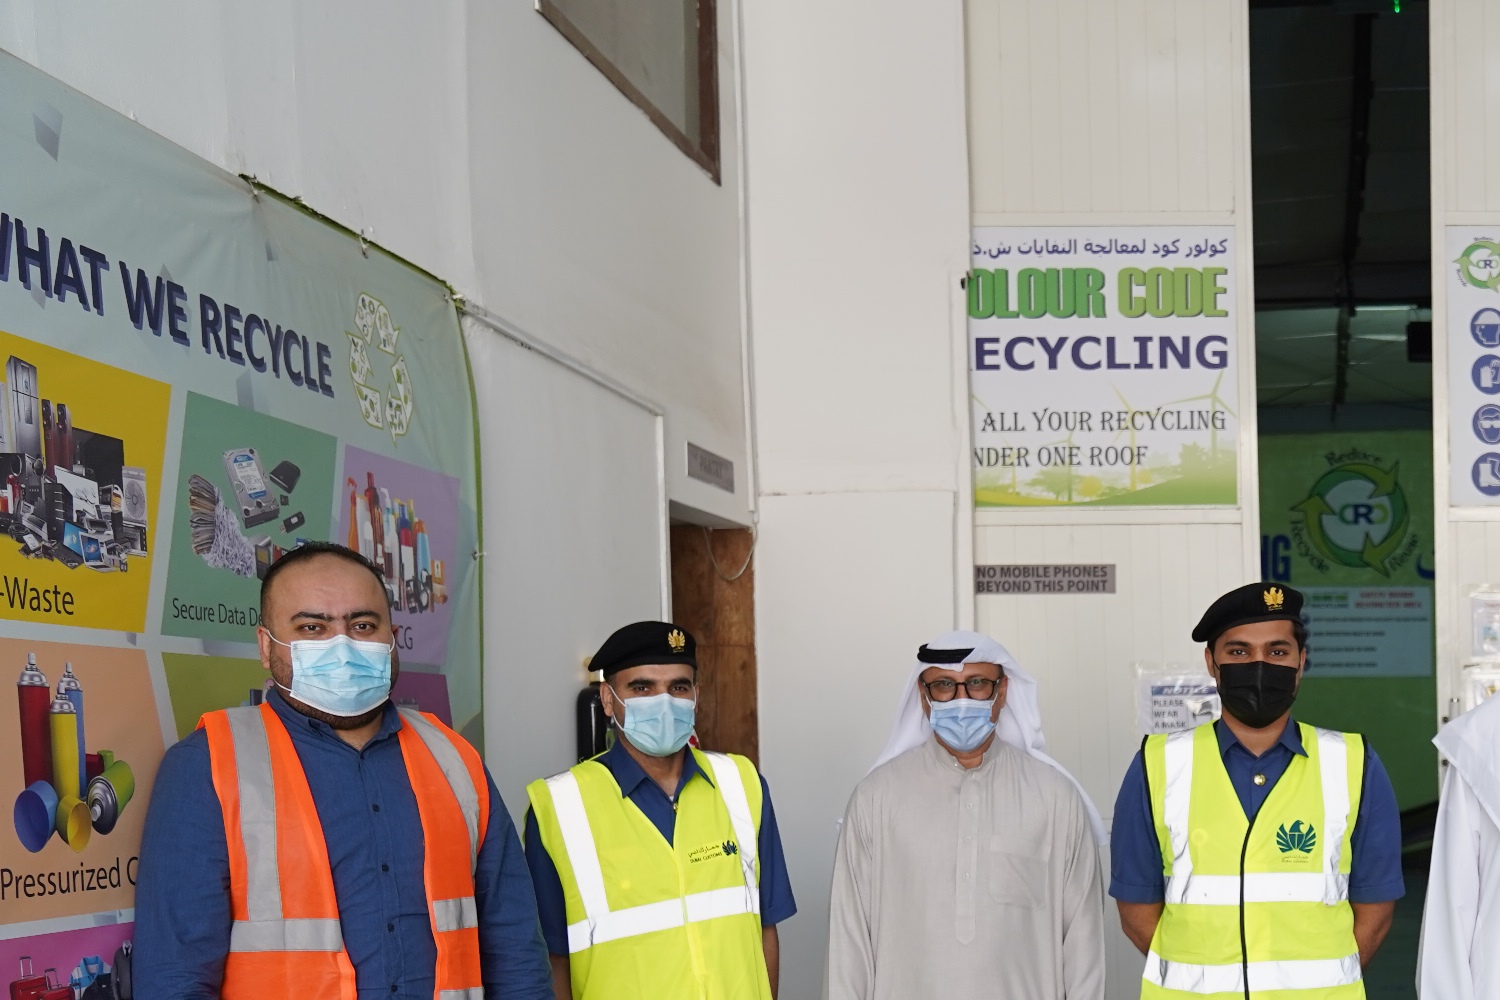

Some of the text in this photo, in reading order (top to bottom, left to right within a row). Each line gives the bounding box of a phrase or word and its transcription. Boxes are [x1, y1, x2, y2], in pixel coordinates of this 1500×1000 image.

[1017, 239, 1078, 258] النفايات
[1084, 238, 1147, 258] لمعالجة
[1152, 238, 1181, 258] كود
[1185, 238, 1228, 258] كولور
[1117, 267, 1228, 318] CODE
[119, 261, 190, 347] WE
[200, 293, 335, 398] RECYCLE
[974, 335, 1228, 371] ECYCLING
[981, 407, 1226, 432] ALL YOUR RECYCLING
[1038, 446, 1082, 467] ONE
[1090, 446, 1148, 467] ROOF
[977, 566, 1108, 579] NO MOBILE PHONES
[977, 580, 1108, 593] BEYOND THIS POINT
[172, 597, 215, 623] Secure
[218, 602, 246, 626] Data
[1154, 710, 1179, 718] WEAR
[1154, 721, 1186, 729] A MASK
[0, 856, 121, 900] Pressurized
